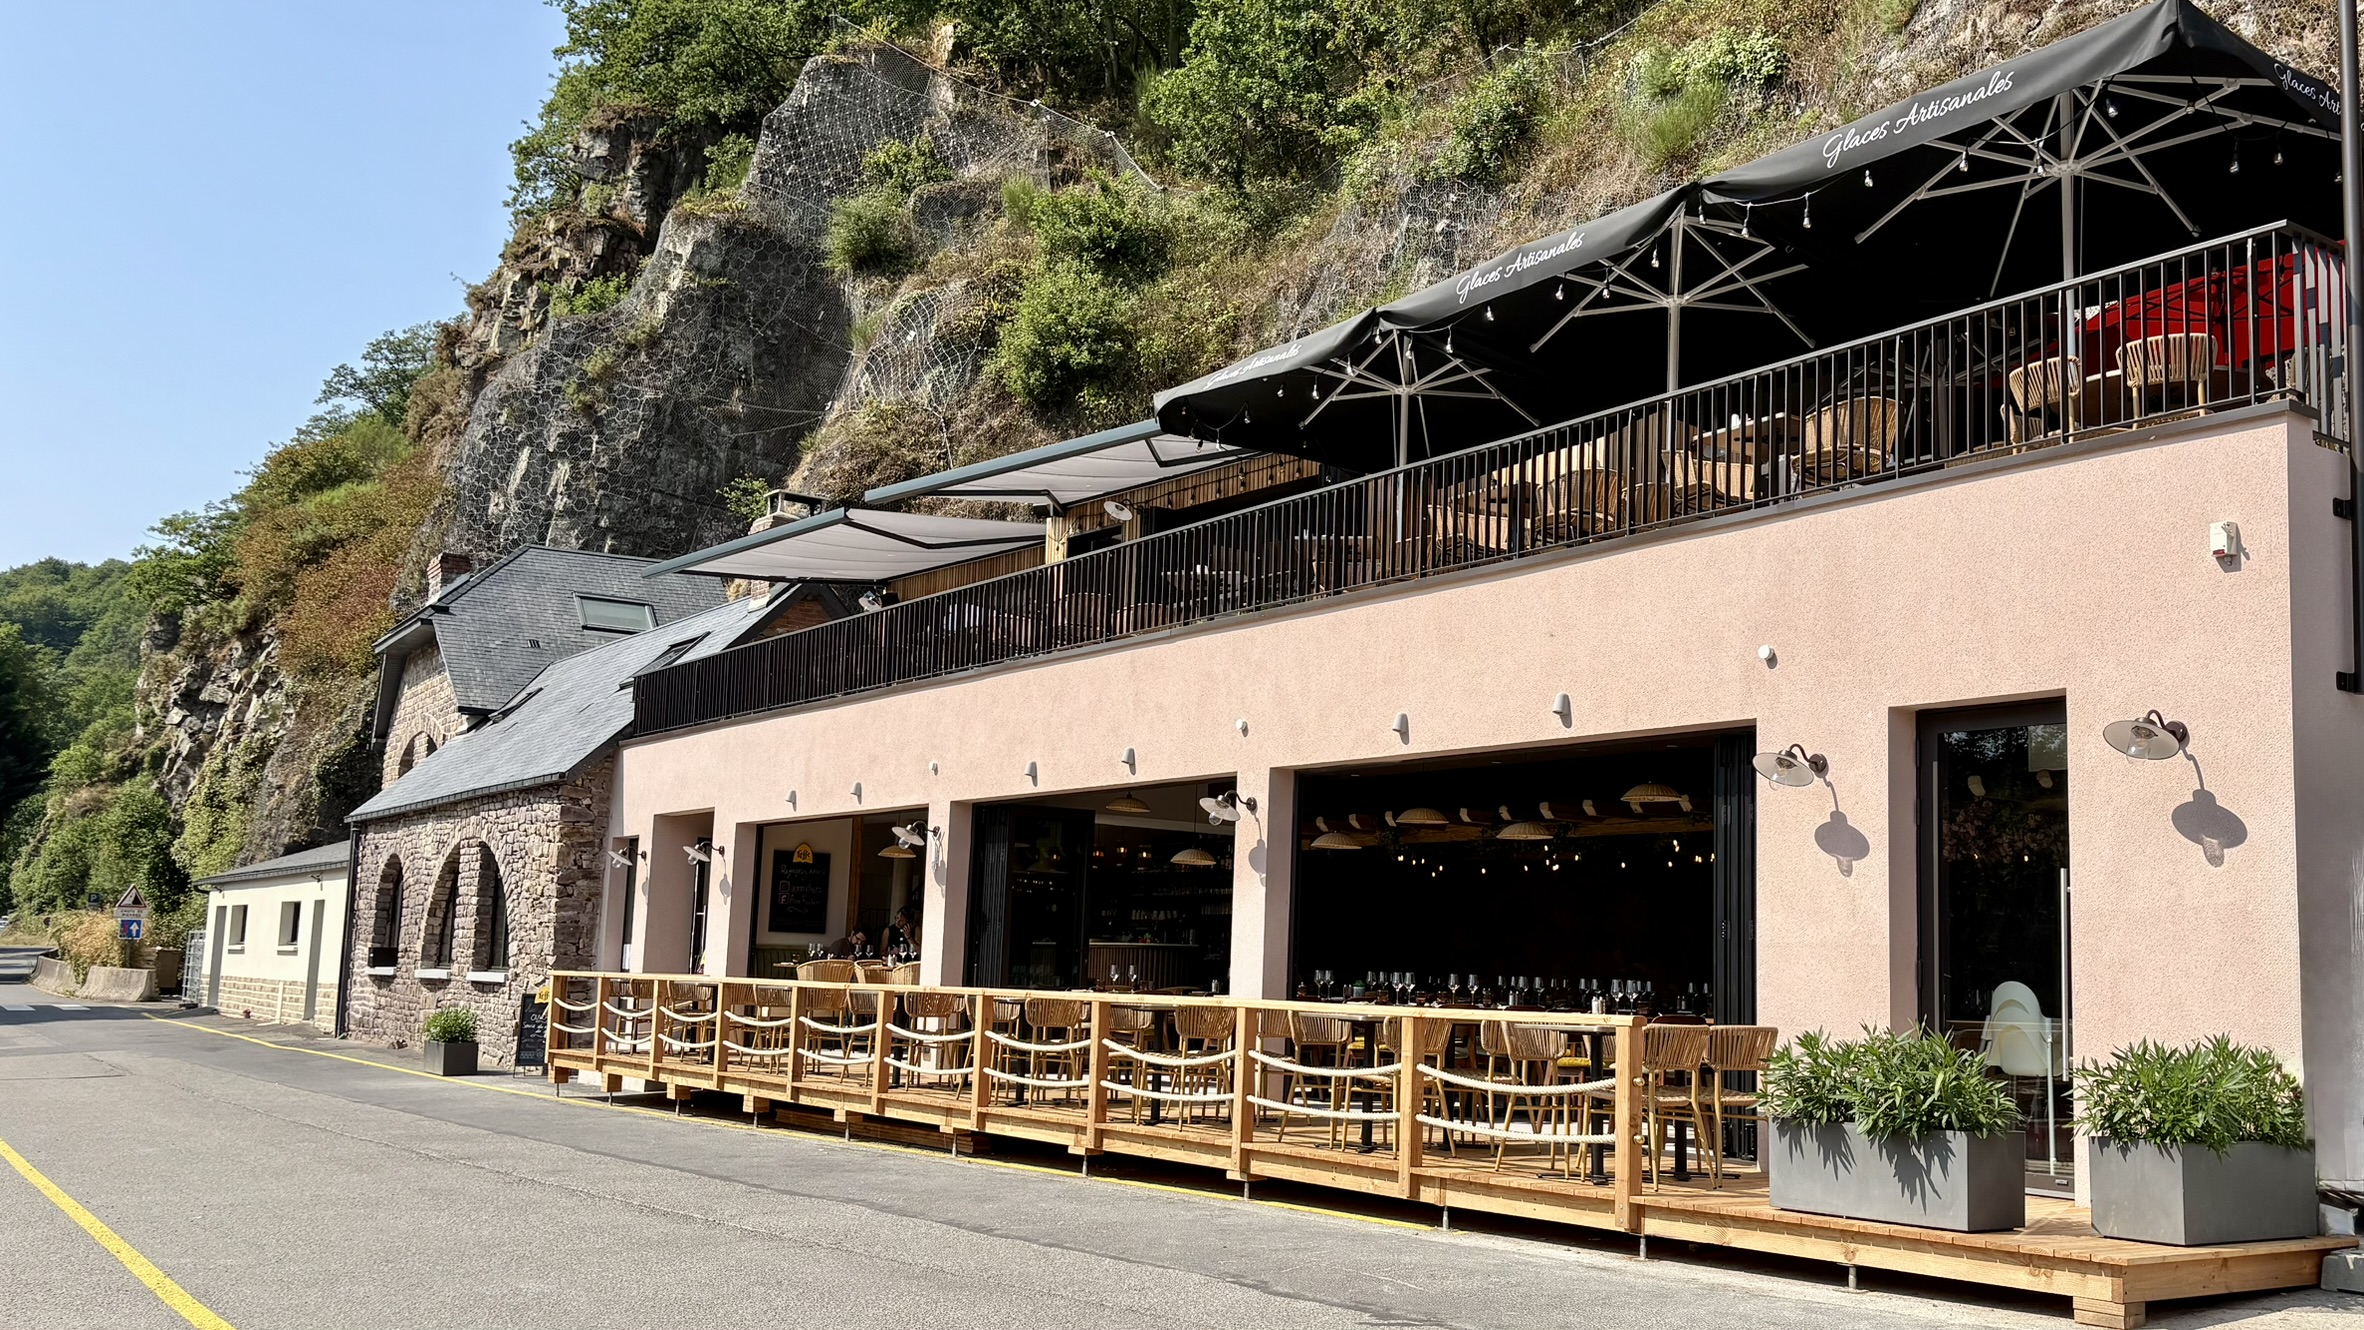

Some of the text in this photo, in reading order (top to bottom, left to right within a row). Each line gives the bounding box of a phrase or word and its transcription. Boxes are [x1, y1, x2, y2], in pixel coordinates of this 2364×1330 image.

[2273, 63, 2317, 100] Glaces
[1822, 70, 2015, 169] Glaces Artisanales
[1456, 231, 1585, 304] Glaces Artisanales
[90, 894, 97, 902] P
